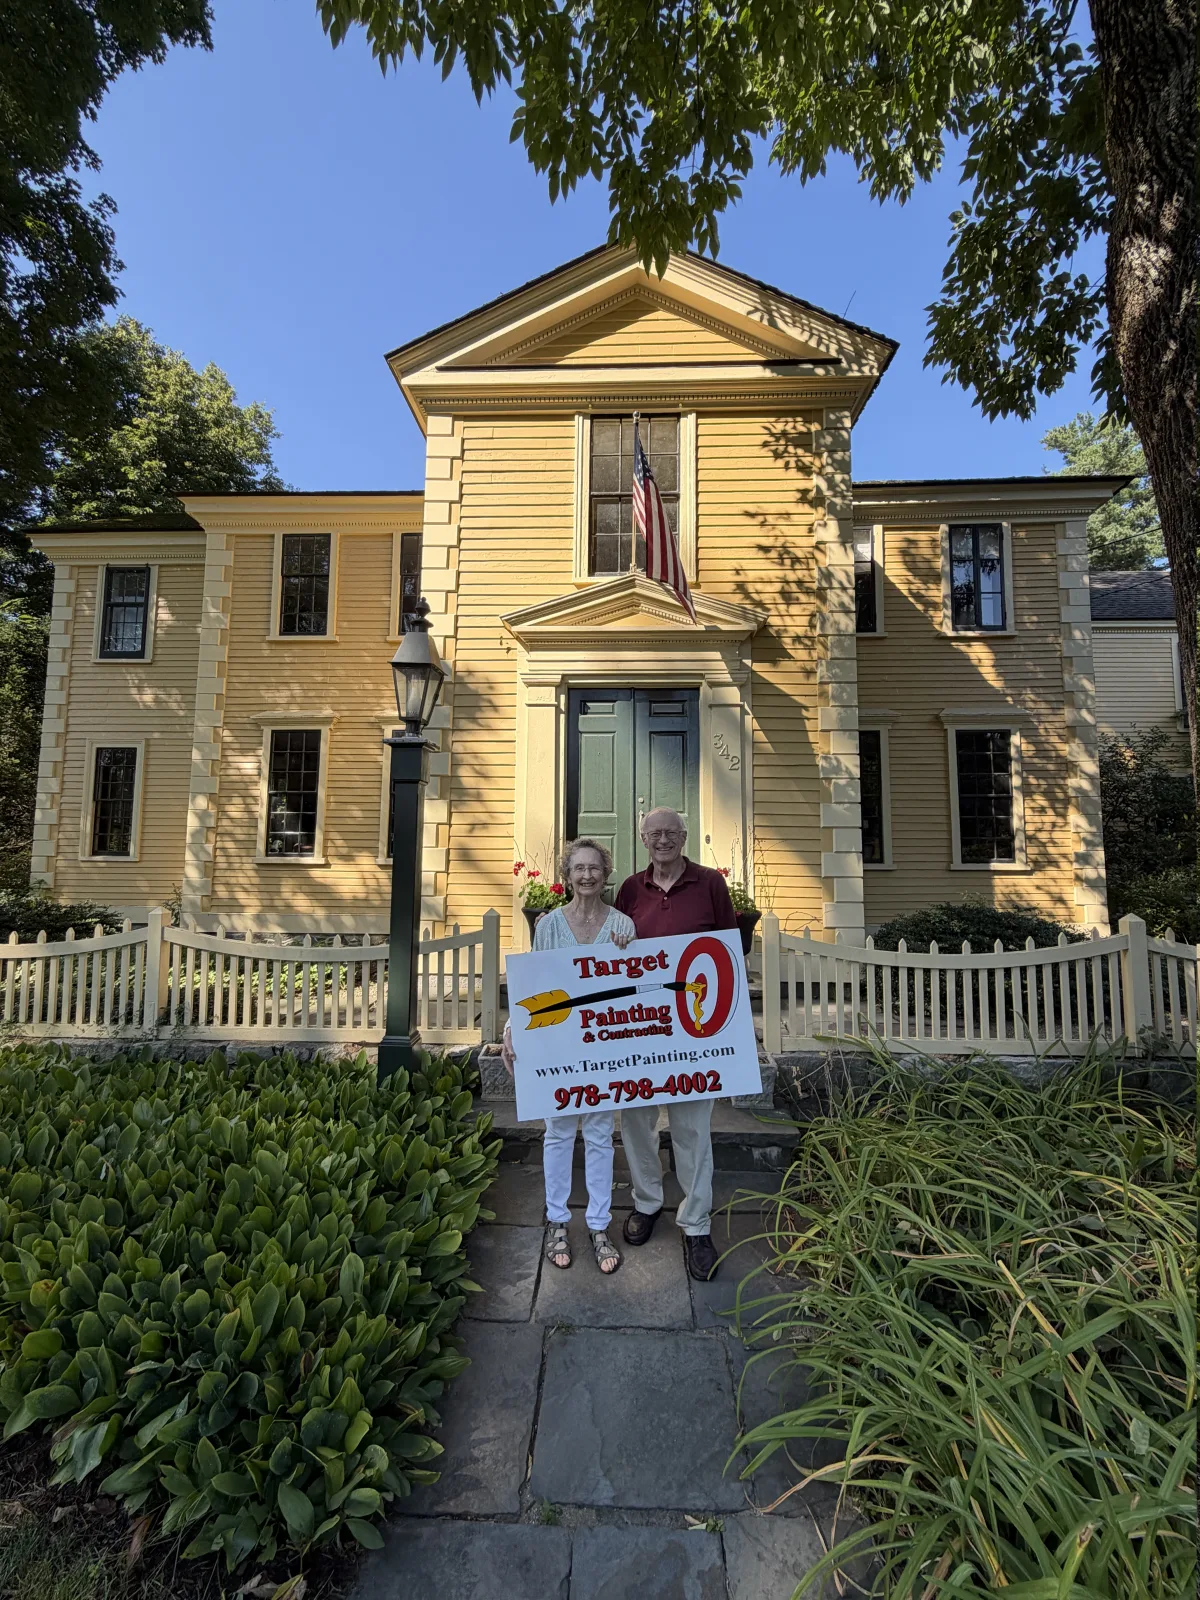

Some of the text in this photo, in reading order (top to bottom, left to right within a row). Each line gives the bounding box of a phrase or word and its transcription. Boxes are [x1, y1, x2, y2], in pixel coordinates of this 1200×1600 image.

[713, 733, 740, 771] 342
[573, 949, 669, 979] Target
[579, 1003, 672, 1029] Painting
[582, 1023, 673, 1043] & Contracting
[535, 1045, 735, 1078] www.TargetPainting.com
[554, 1069, 722, 1110] 978-798-4002
